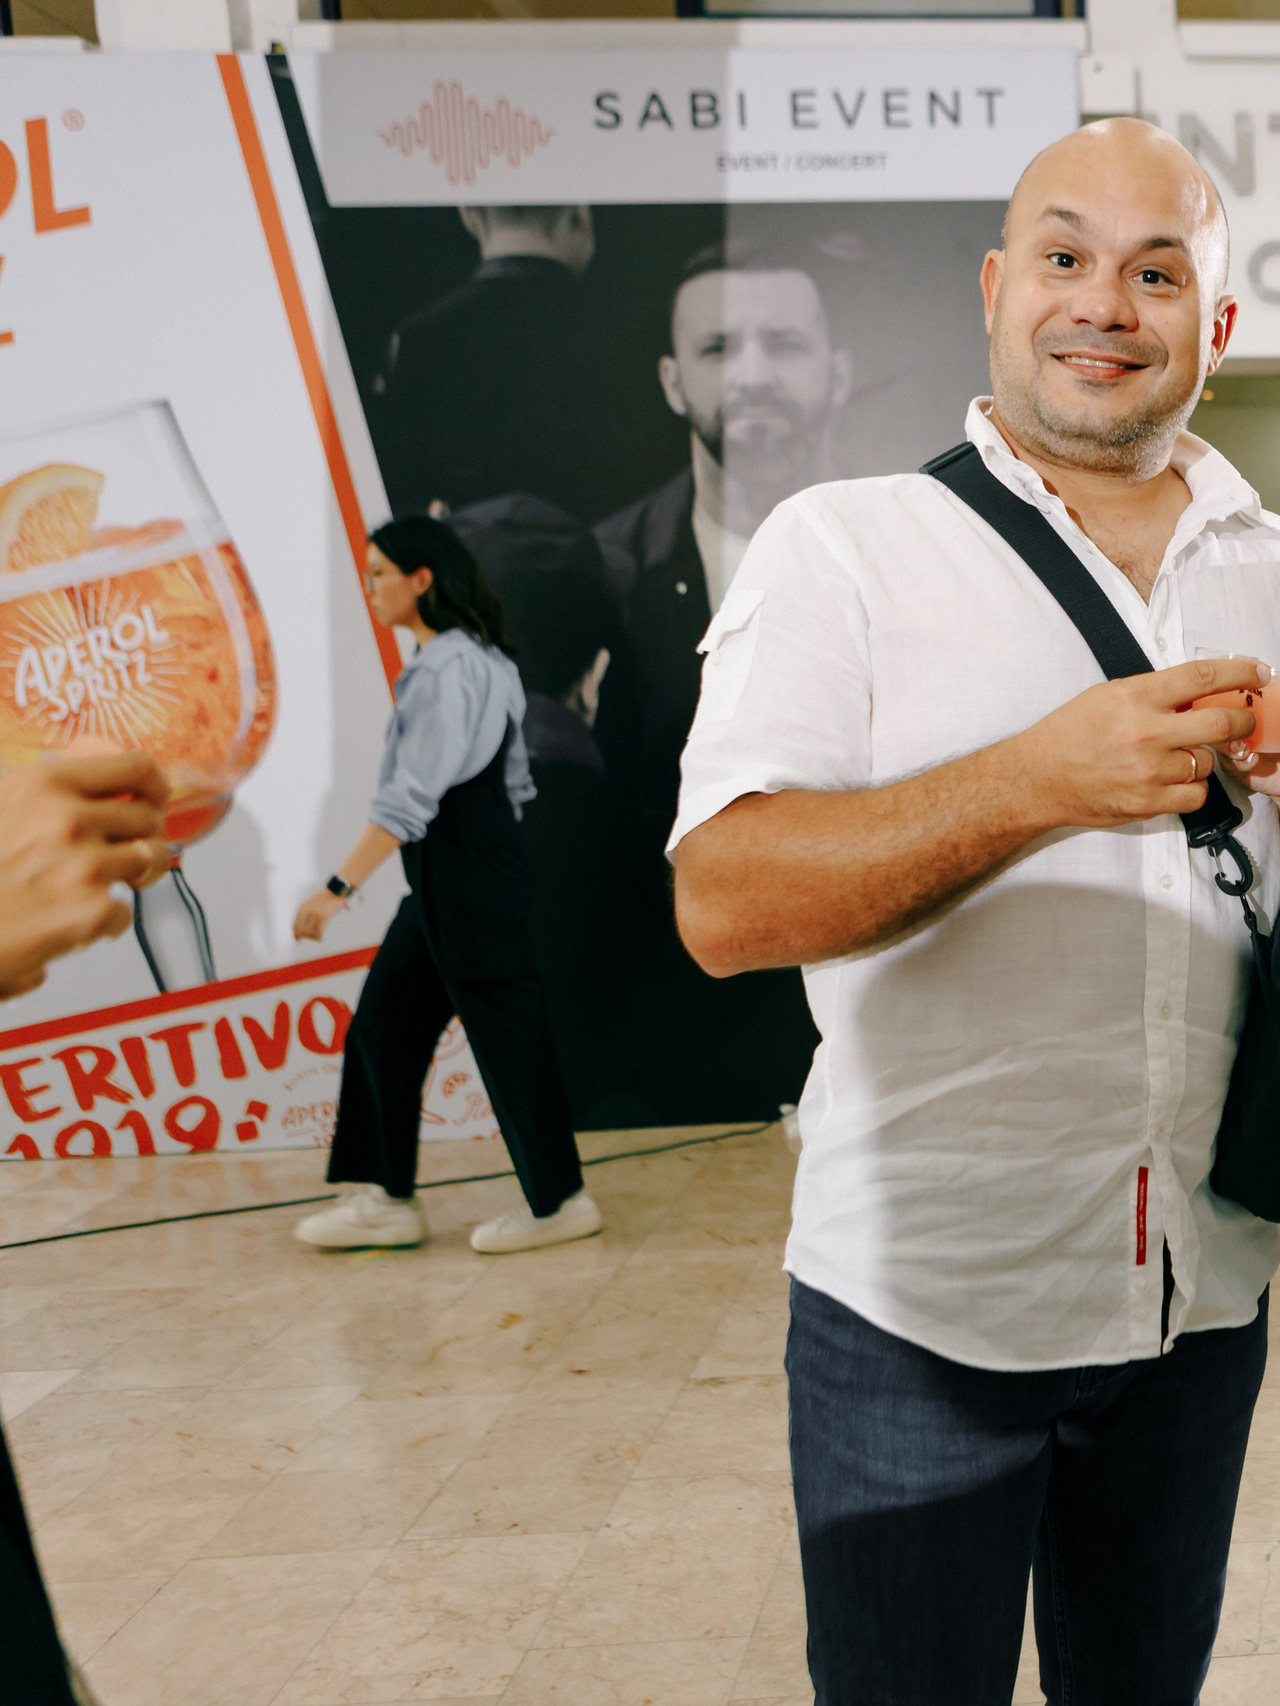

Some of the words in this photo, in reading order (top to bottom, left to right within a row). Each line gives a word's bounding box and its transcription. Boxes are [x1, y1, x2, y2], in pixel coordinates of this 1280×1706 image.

[594, 89, 748, 131] SABI
[790, 88, 1006, 130] EVENT
[717, 153, 779, 172] EVENT
[797, 153, 888, 172] CONCERT
[15, 603, 170, 708] APEROL
[0, 997, 353, 1123] ERITIVO
